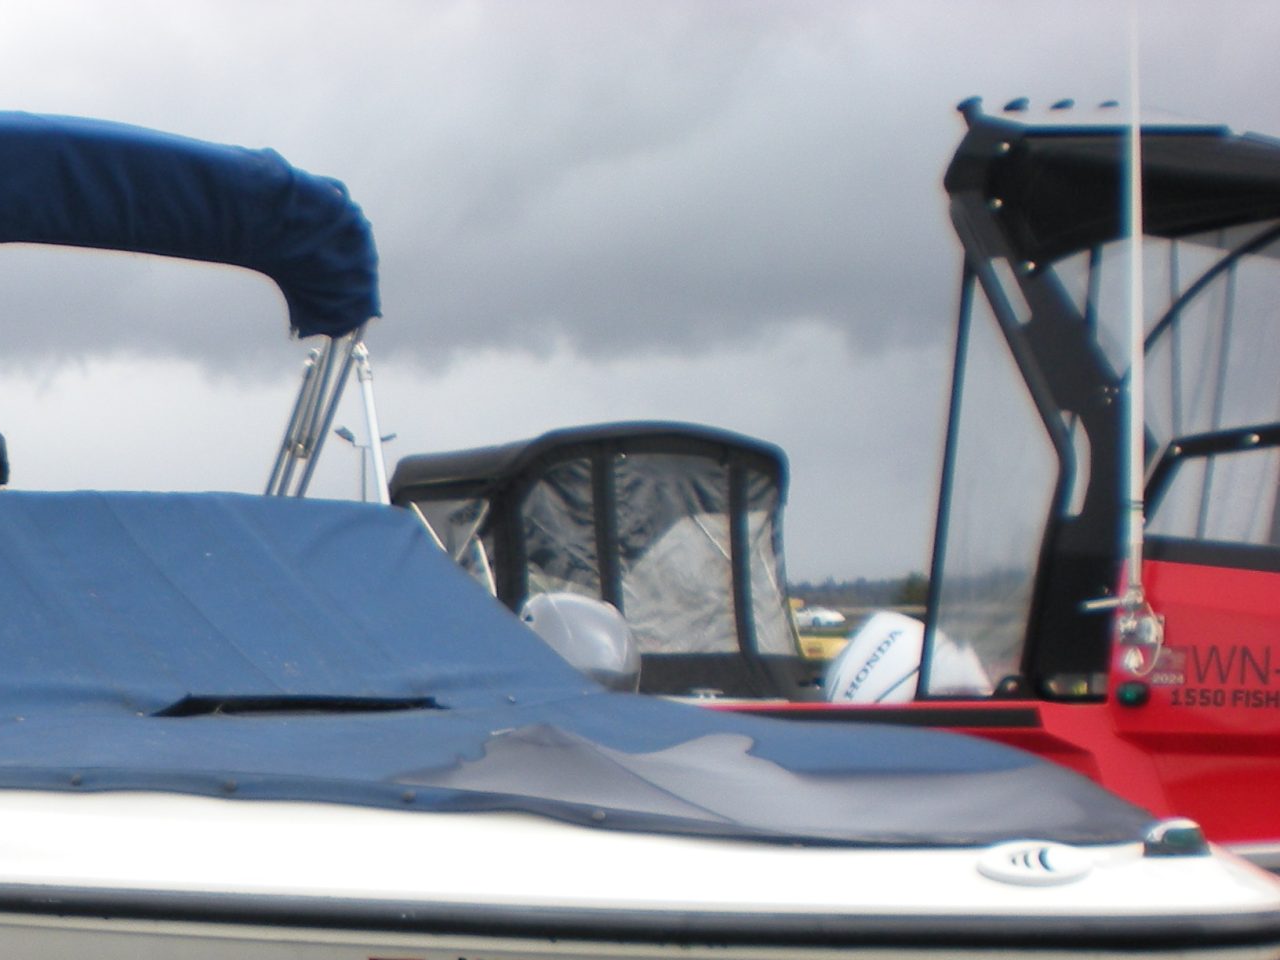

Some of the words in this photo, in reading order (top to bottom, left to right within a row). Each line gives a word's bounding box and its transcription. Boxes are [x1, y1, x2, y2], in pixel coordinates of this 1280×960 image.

[843, 629, 904, 700] HONDA
[1170, 689, 1226, 707] 1550
[1231, 689, 1280, 708] FISH
